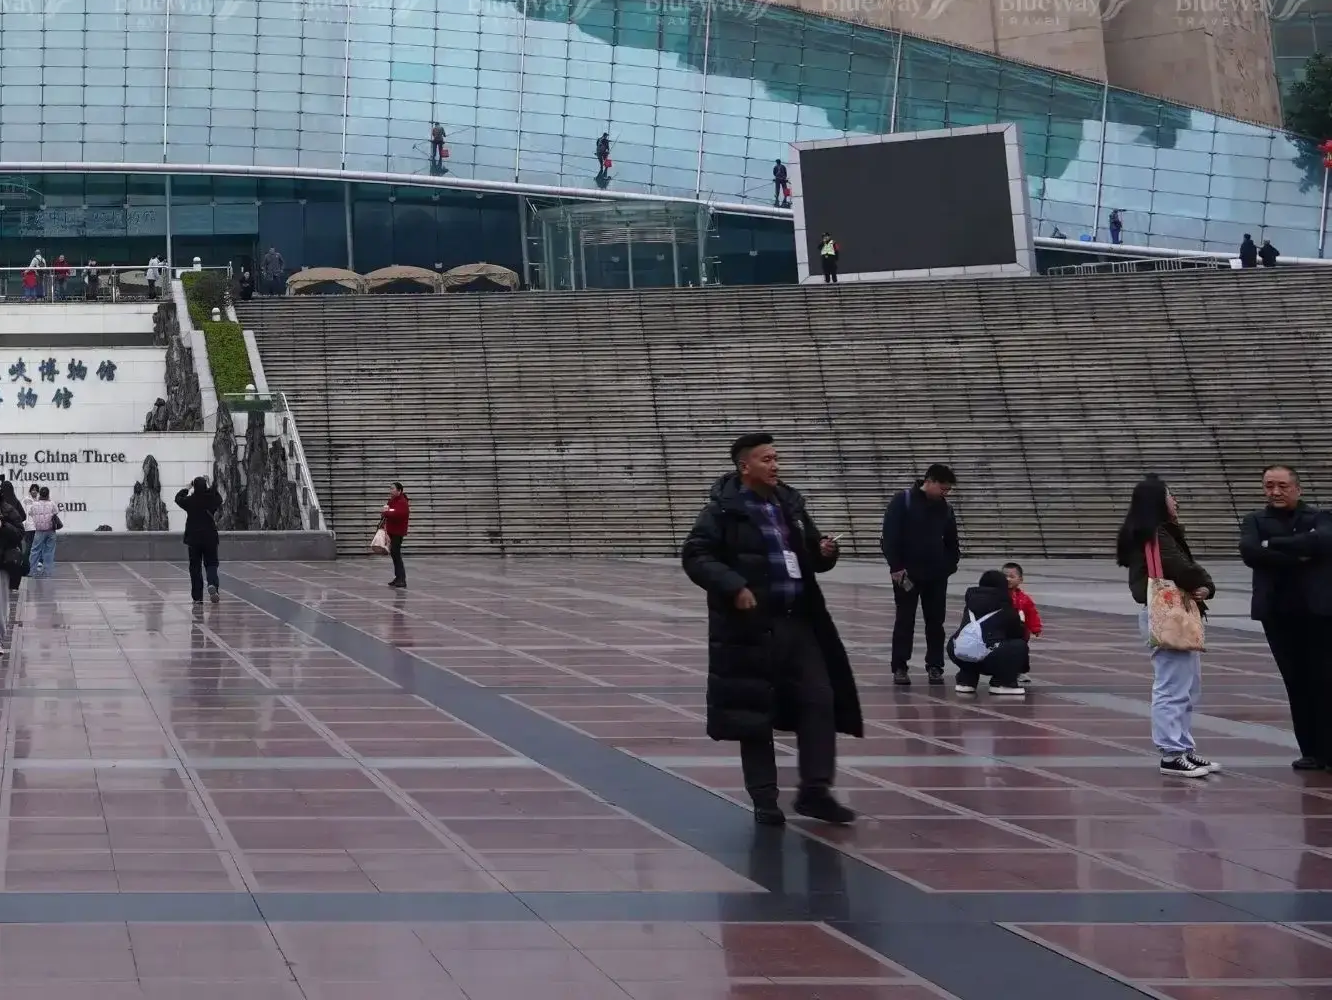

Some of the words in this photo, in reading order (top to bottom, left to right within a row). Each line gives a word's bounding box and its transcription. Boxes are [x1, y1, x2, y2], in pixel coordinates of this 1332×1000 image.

[34, 450, 78, 463] China
[83, 450, 125, 463] Three
[9, 469, 69, 481] Museum
